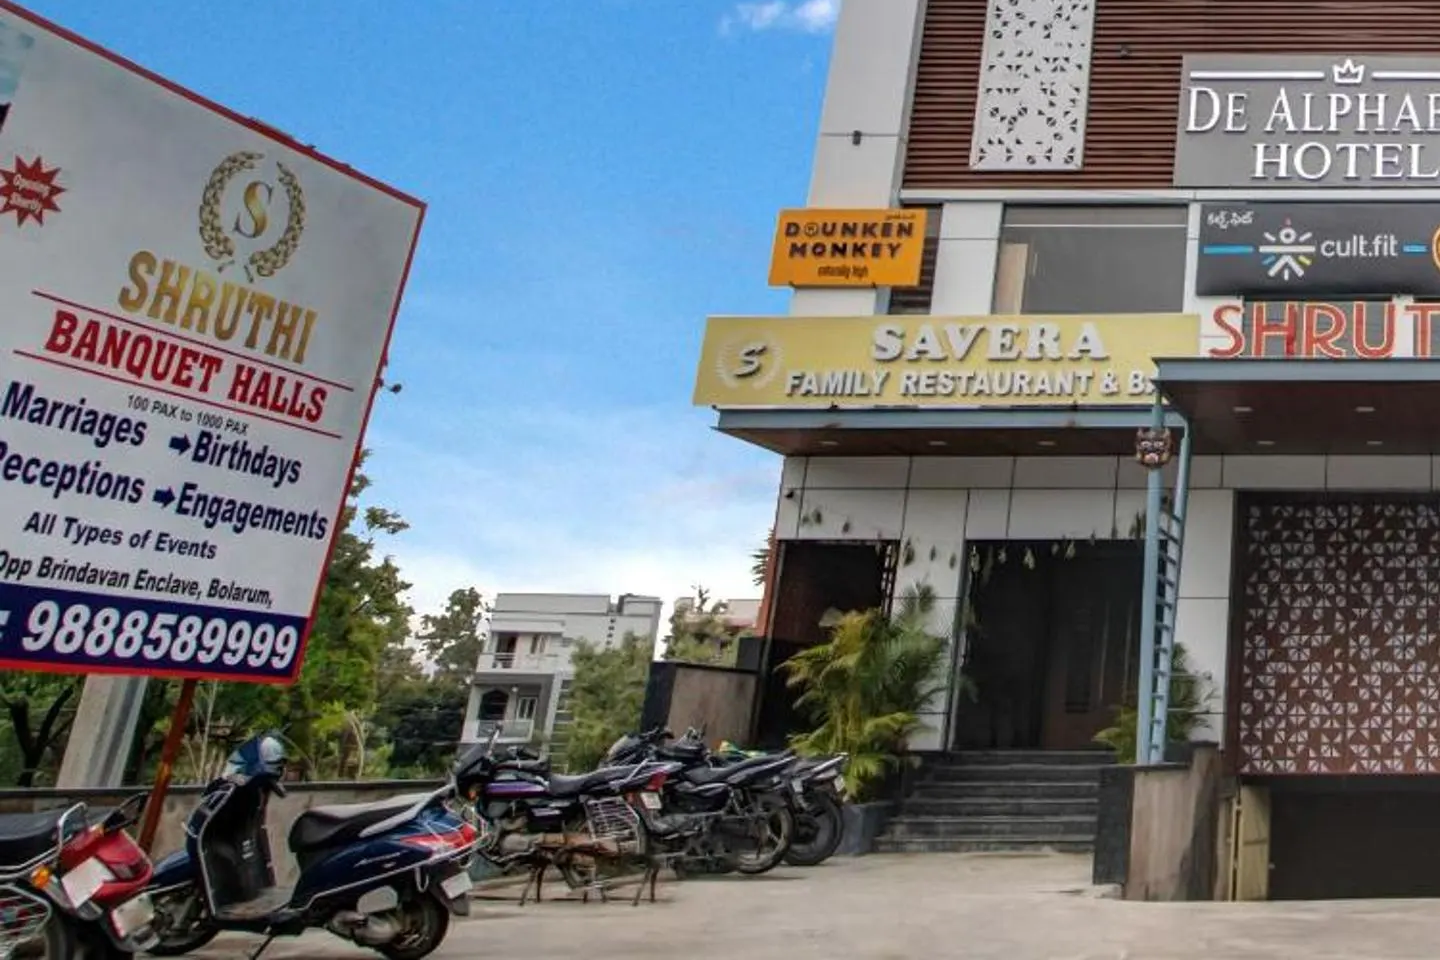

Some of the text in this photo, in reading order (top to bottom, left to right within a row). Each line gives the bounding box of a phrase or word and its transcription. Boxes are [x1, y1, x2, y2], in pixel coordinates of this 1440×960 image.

[1185, 86, 1248, 134] DE
[1250, 141, 1440, 181] HOTEL
[784, 221, 914, 238] DUNKEN
[789, 242, 903, 259] MONKEY
[1320, 234, 1399, 259] cult.fit
[118, 250, 319, 365] SHRUTHI
[45, 309, 328, 423] BANQUET HALLS
[870, 322, 1112, 363] SAVERA
[784, 369, 891, 398] FAMILY
[902, 368, 1095, 398] RESTAURANT
[1100, 368, 1120, 394] &
[1, 380, 302, 489] Marriages Birthdays
[127, 394, 250, 437] 100 PAX to 1000 PAX
[175, 481, 329, 541] Engagements
[23, 511, 218, 560] All Types of Events
[0, 550, 273, 609] Opp Brindavan Enclave, Bolarum,
[22, 599, 299, 670] 9888589999
